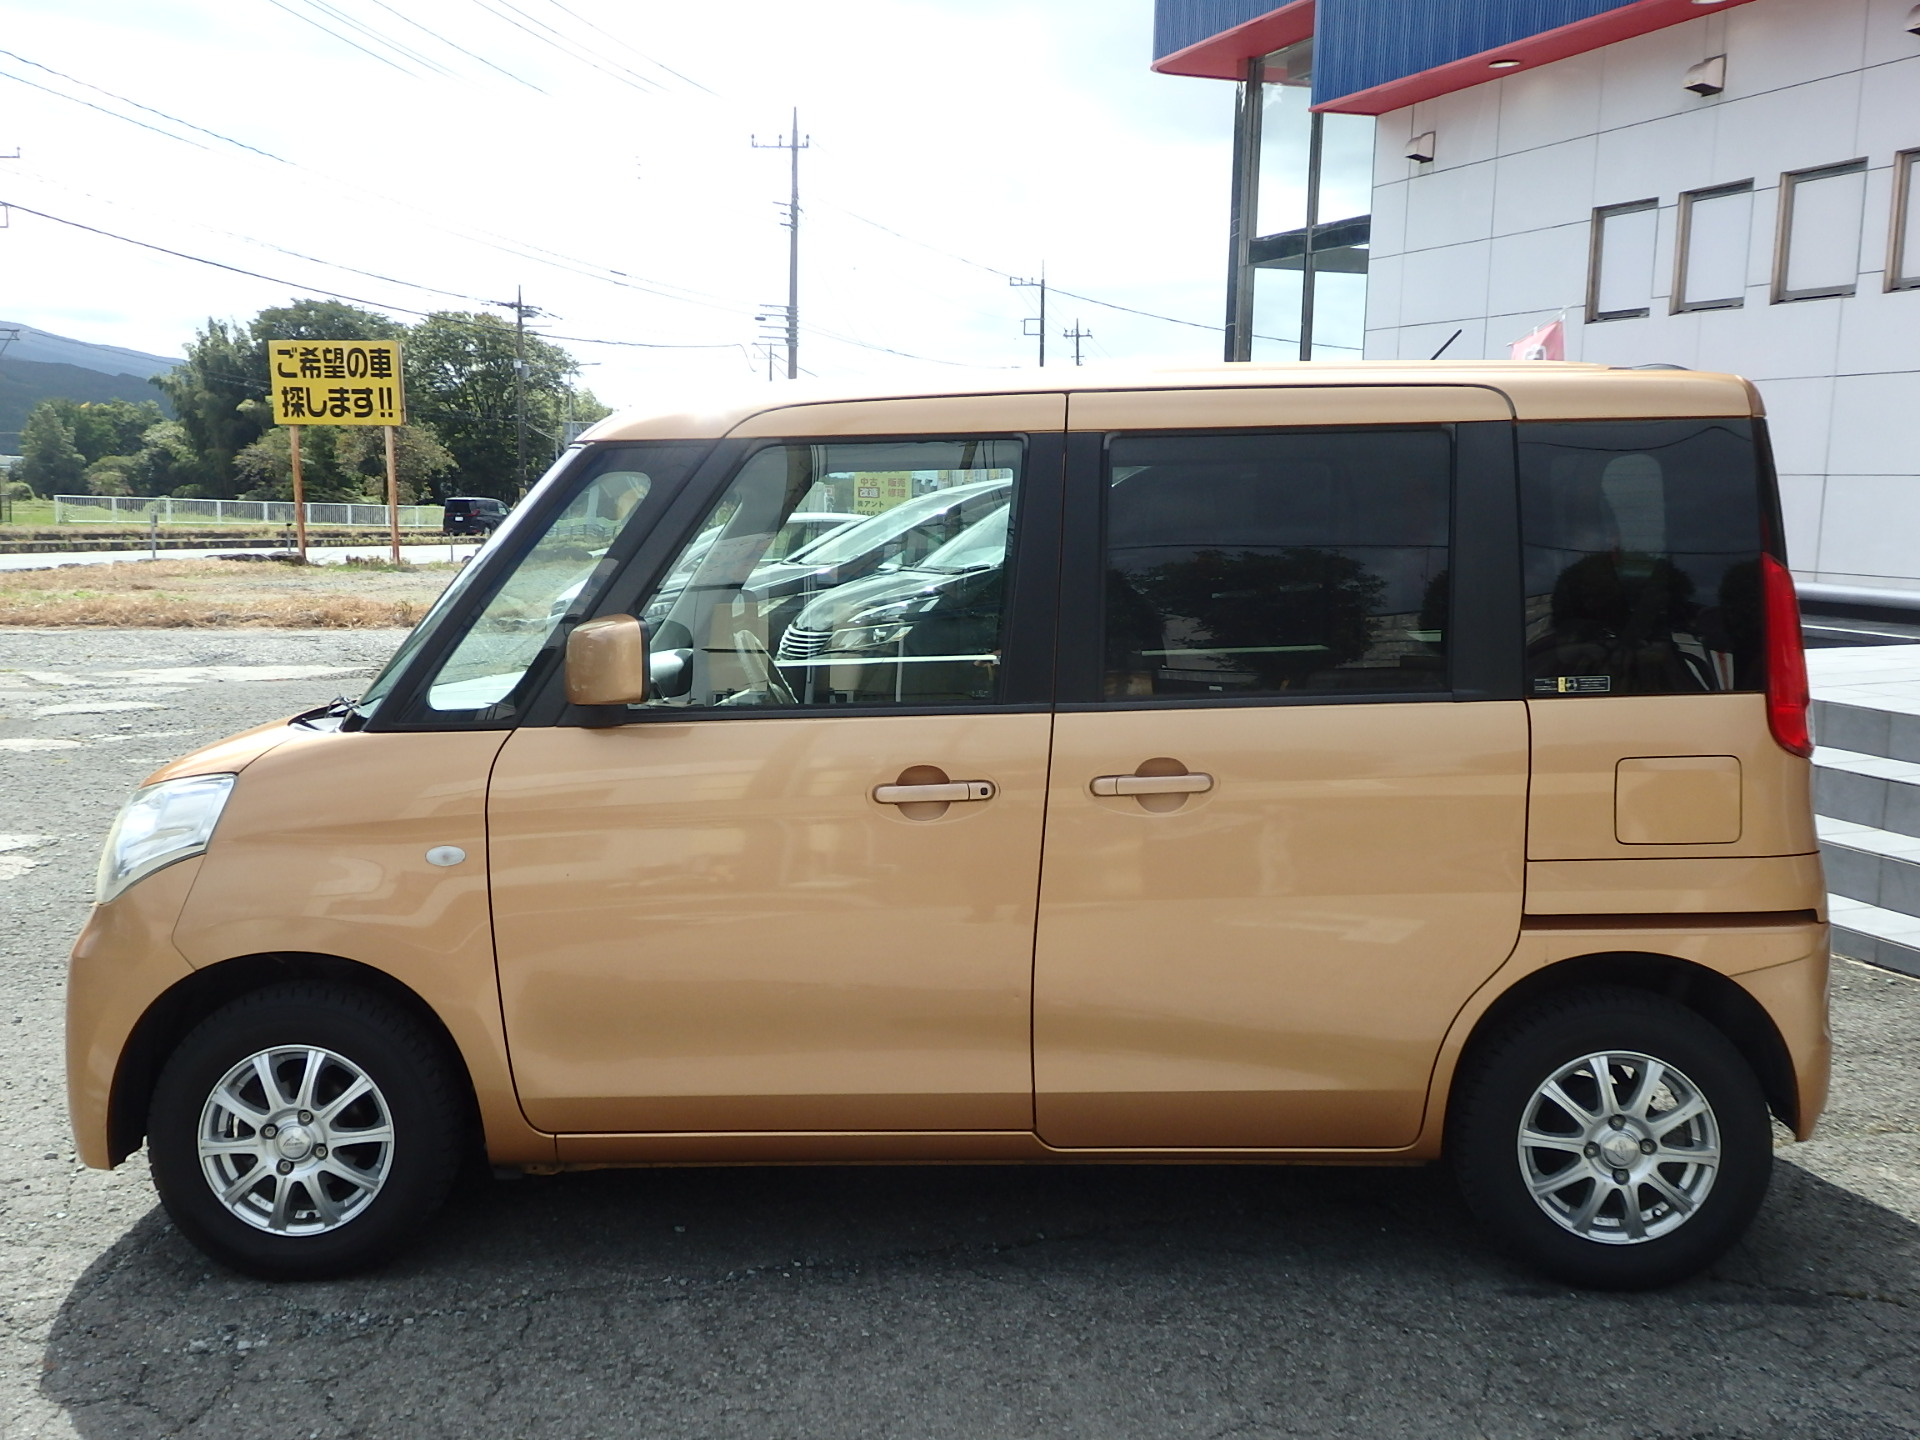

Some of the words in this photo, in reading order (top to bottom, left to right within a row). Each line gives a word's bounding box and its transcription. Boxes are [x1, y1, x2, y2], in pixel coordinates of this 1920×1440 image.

[277, 347, 392, 379] ご希望の車
